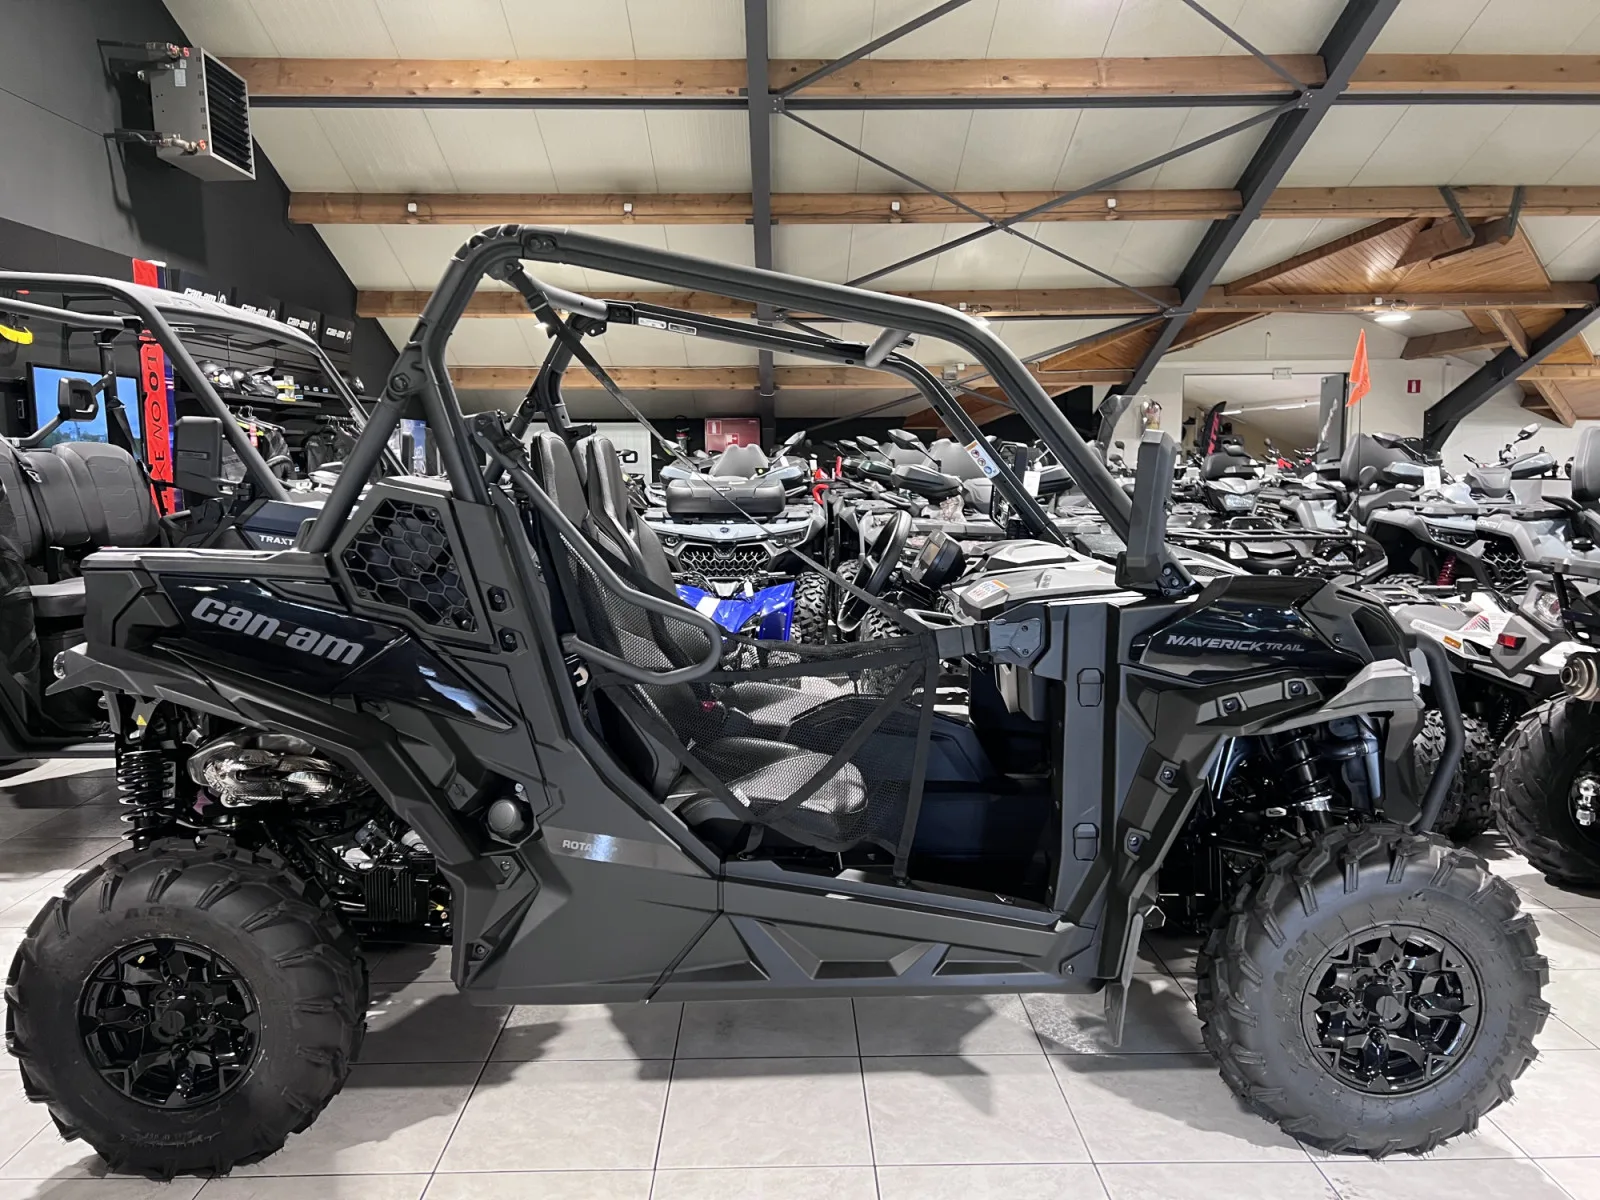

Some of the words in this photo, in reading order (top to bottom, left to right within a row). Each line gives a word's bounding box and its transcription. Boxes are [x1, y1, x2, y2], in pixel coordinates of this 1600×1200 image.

[151, 400, 164, 441] NO
[259, 534, 295, 546] TRAXT
[191, 597, 364, 665] can-am
[1166, 634, 1265, 652] MAVERICK
[1265, 642, 1305, 652] TRAIL
[562, 839, 593, 852] ROTA
